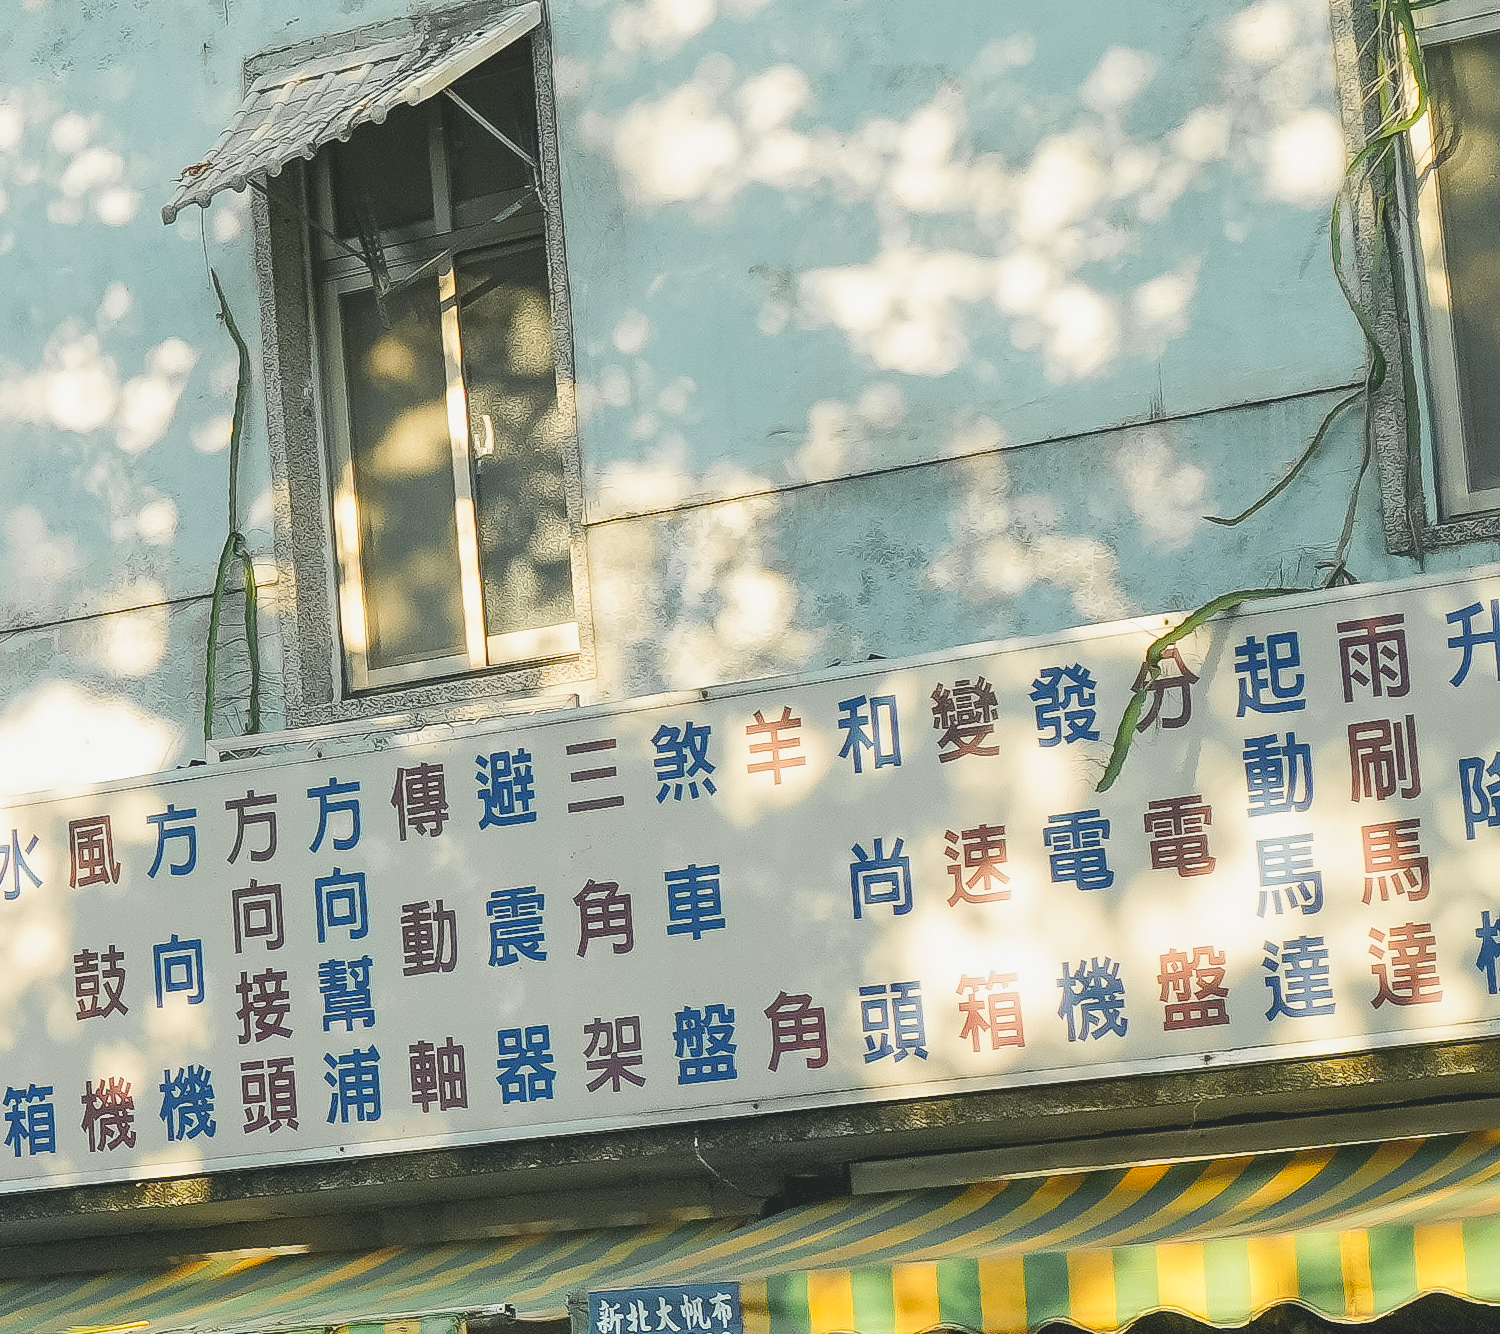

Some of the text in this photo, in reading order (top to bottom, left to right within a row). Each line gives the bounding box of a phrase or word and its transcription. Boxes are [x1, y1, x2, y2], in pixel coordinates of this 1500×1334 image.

[68, 816, 137, 1151] 風鼓機
[147, 804, 217, 1142] 方向機
[224, 789, 299, 1135] 方向接頭
[306, 777, 382, 1124] 方向幫浦
[390, 763, 469, 1114] 傳動軸
[476, 751, 557, 1105] 避震器
[565, 737, 647, 1094] 三角架
[651, 722, 739, 1085] 煞車盤
[745, 706, 831, 1071] 羊角
[837, 694, 929, 1064] 和尚頭
[930, 676, 1027, 1053] 變速箱
[1030, 663, 1129, 1042] 發電機
[1131, 648, 1232, 1031] 分電盤
[1234, 632, 1335, 1022] 起動馬達
[1337, 613, 1443, 1008] 雨刷馬達
